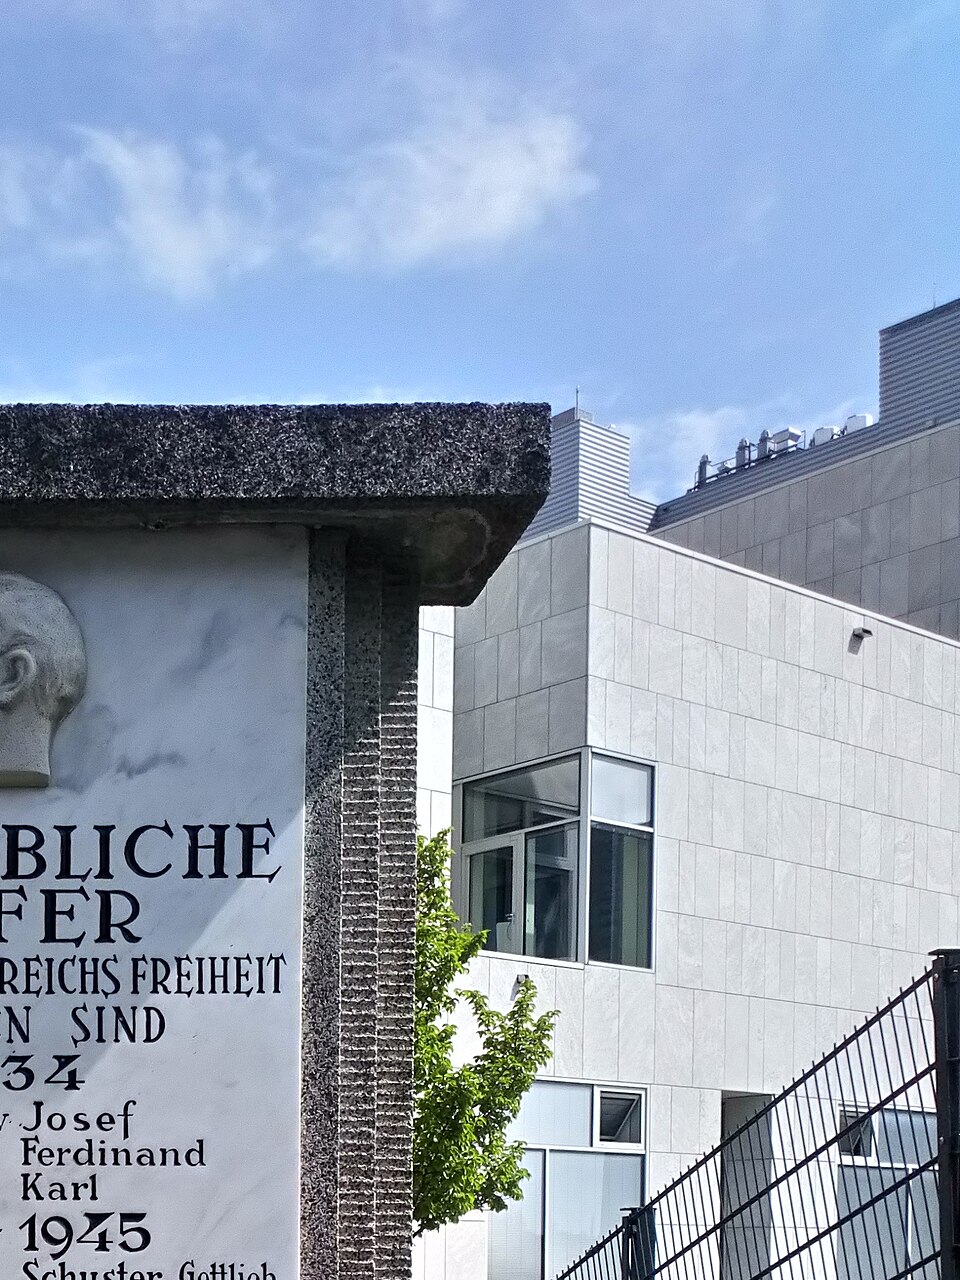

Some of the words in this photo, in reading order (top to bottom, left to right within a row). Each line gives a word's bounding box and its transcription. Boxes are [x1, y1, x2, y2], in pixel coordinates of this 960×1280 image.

[130, 952, 288, 997] FREIHEIT
[70, 1002, 166, 1048] SIND
[22, 1099, 137, 1140] Josef
[19, 1138, 207, 1167] Ferdinand
[20, 1172, 99, 1202] Karl
[18, 1211, 152, 1262] 1945
